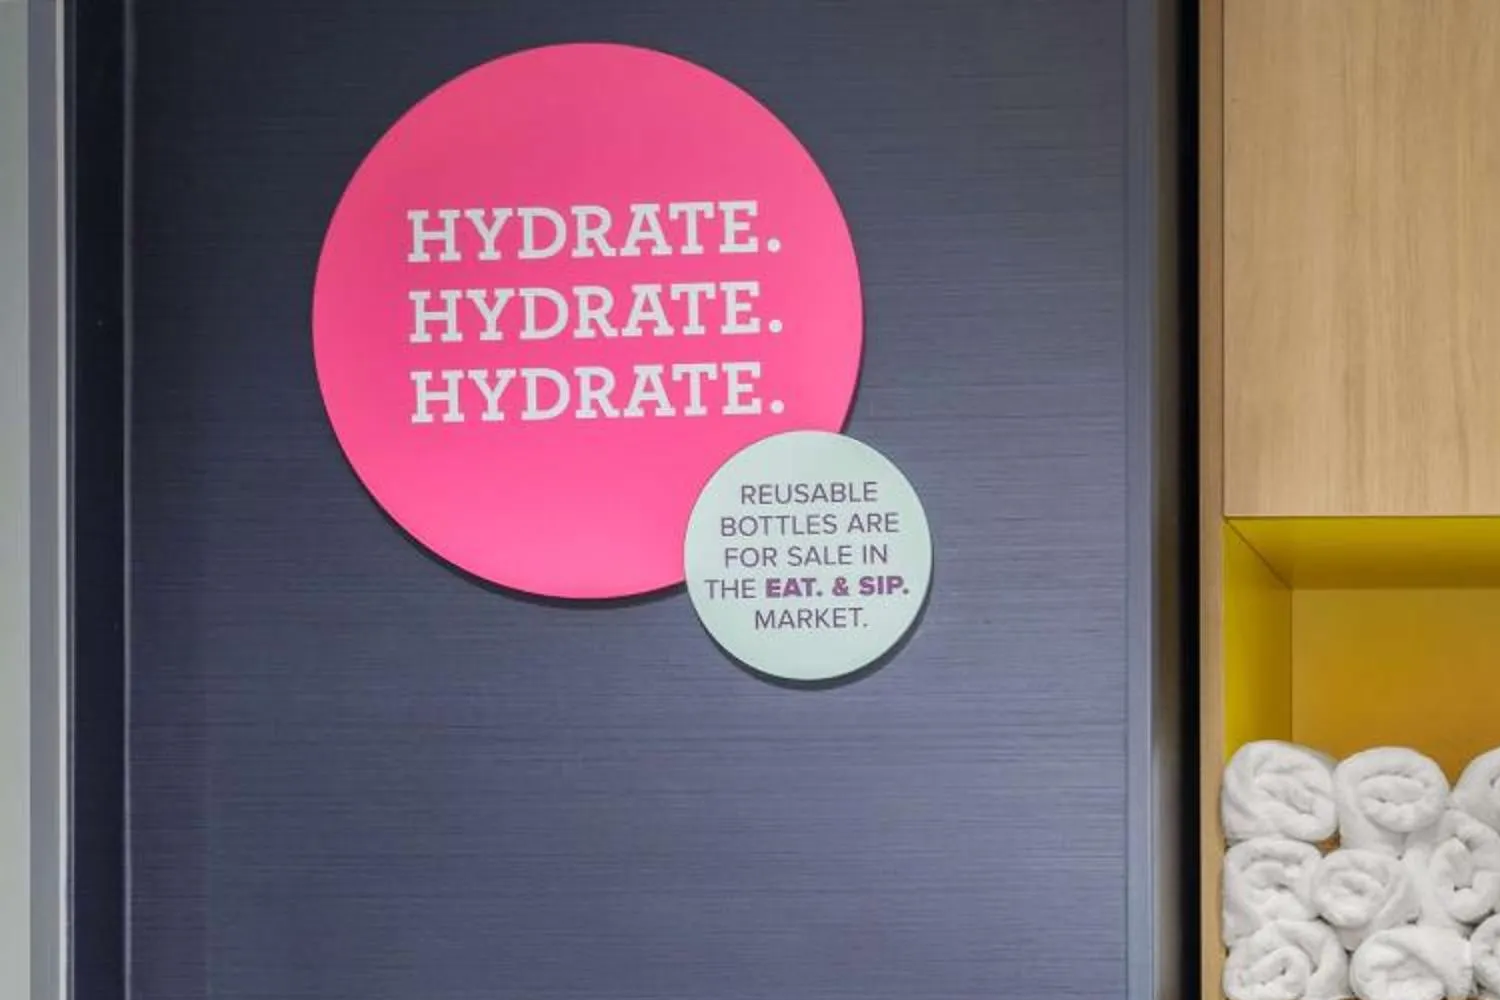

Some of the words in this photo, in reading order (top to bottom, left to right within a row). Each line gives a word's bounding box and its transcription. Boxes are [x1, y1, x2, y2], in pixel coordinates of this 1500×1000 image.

[407, 200, 781, 263] HYDRATE.
[408, 281, 783, 343] HYDRATE.
[410, 361, 785, 424] HYDRATE.
[741, 481, 878, 505] REUSABLE
[720, 513, 838, 537] BOTTLES
[847, 512, 899, 534] ARE
[724, 547, 777, 568] FOR
[787, 545, 852, 567] SALE
[862, 544, 888, 565] IN
[705, 579, 757, 600] THE
[765, 577, 823, 598] EAT.
[831, 576, 849, 597] &
[858, 575, 909, 596] SIP.
[755, 607, 868, 630] MARKET.
